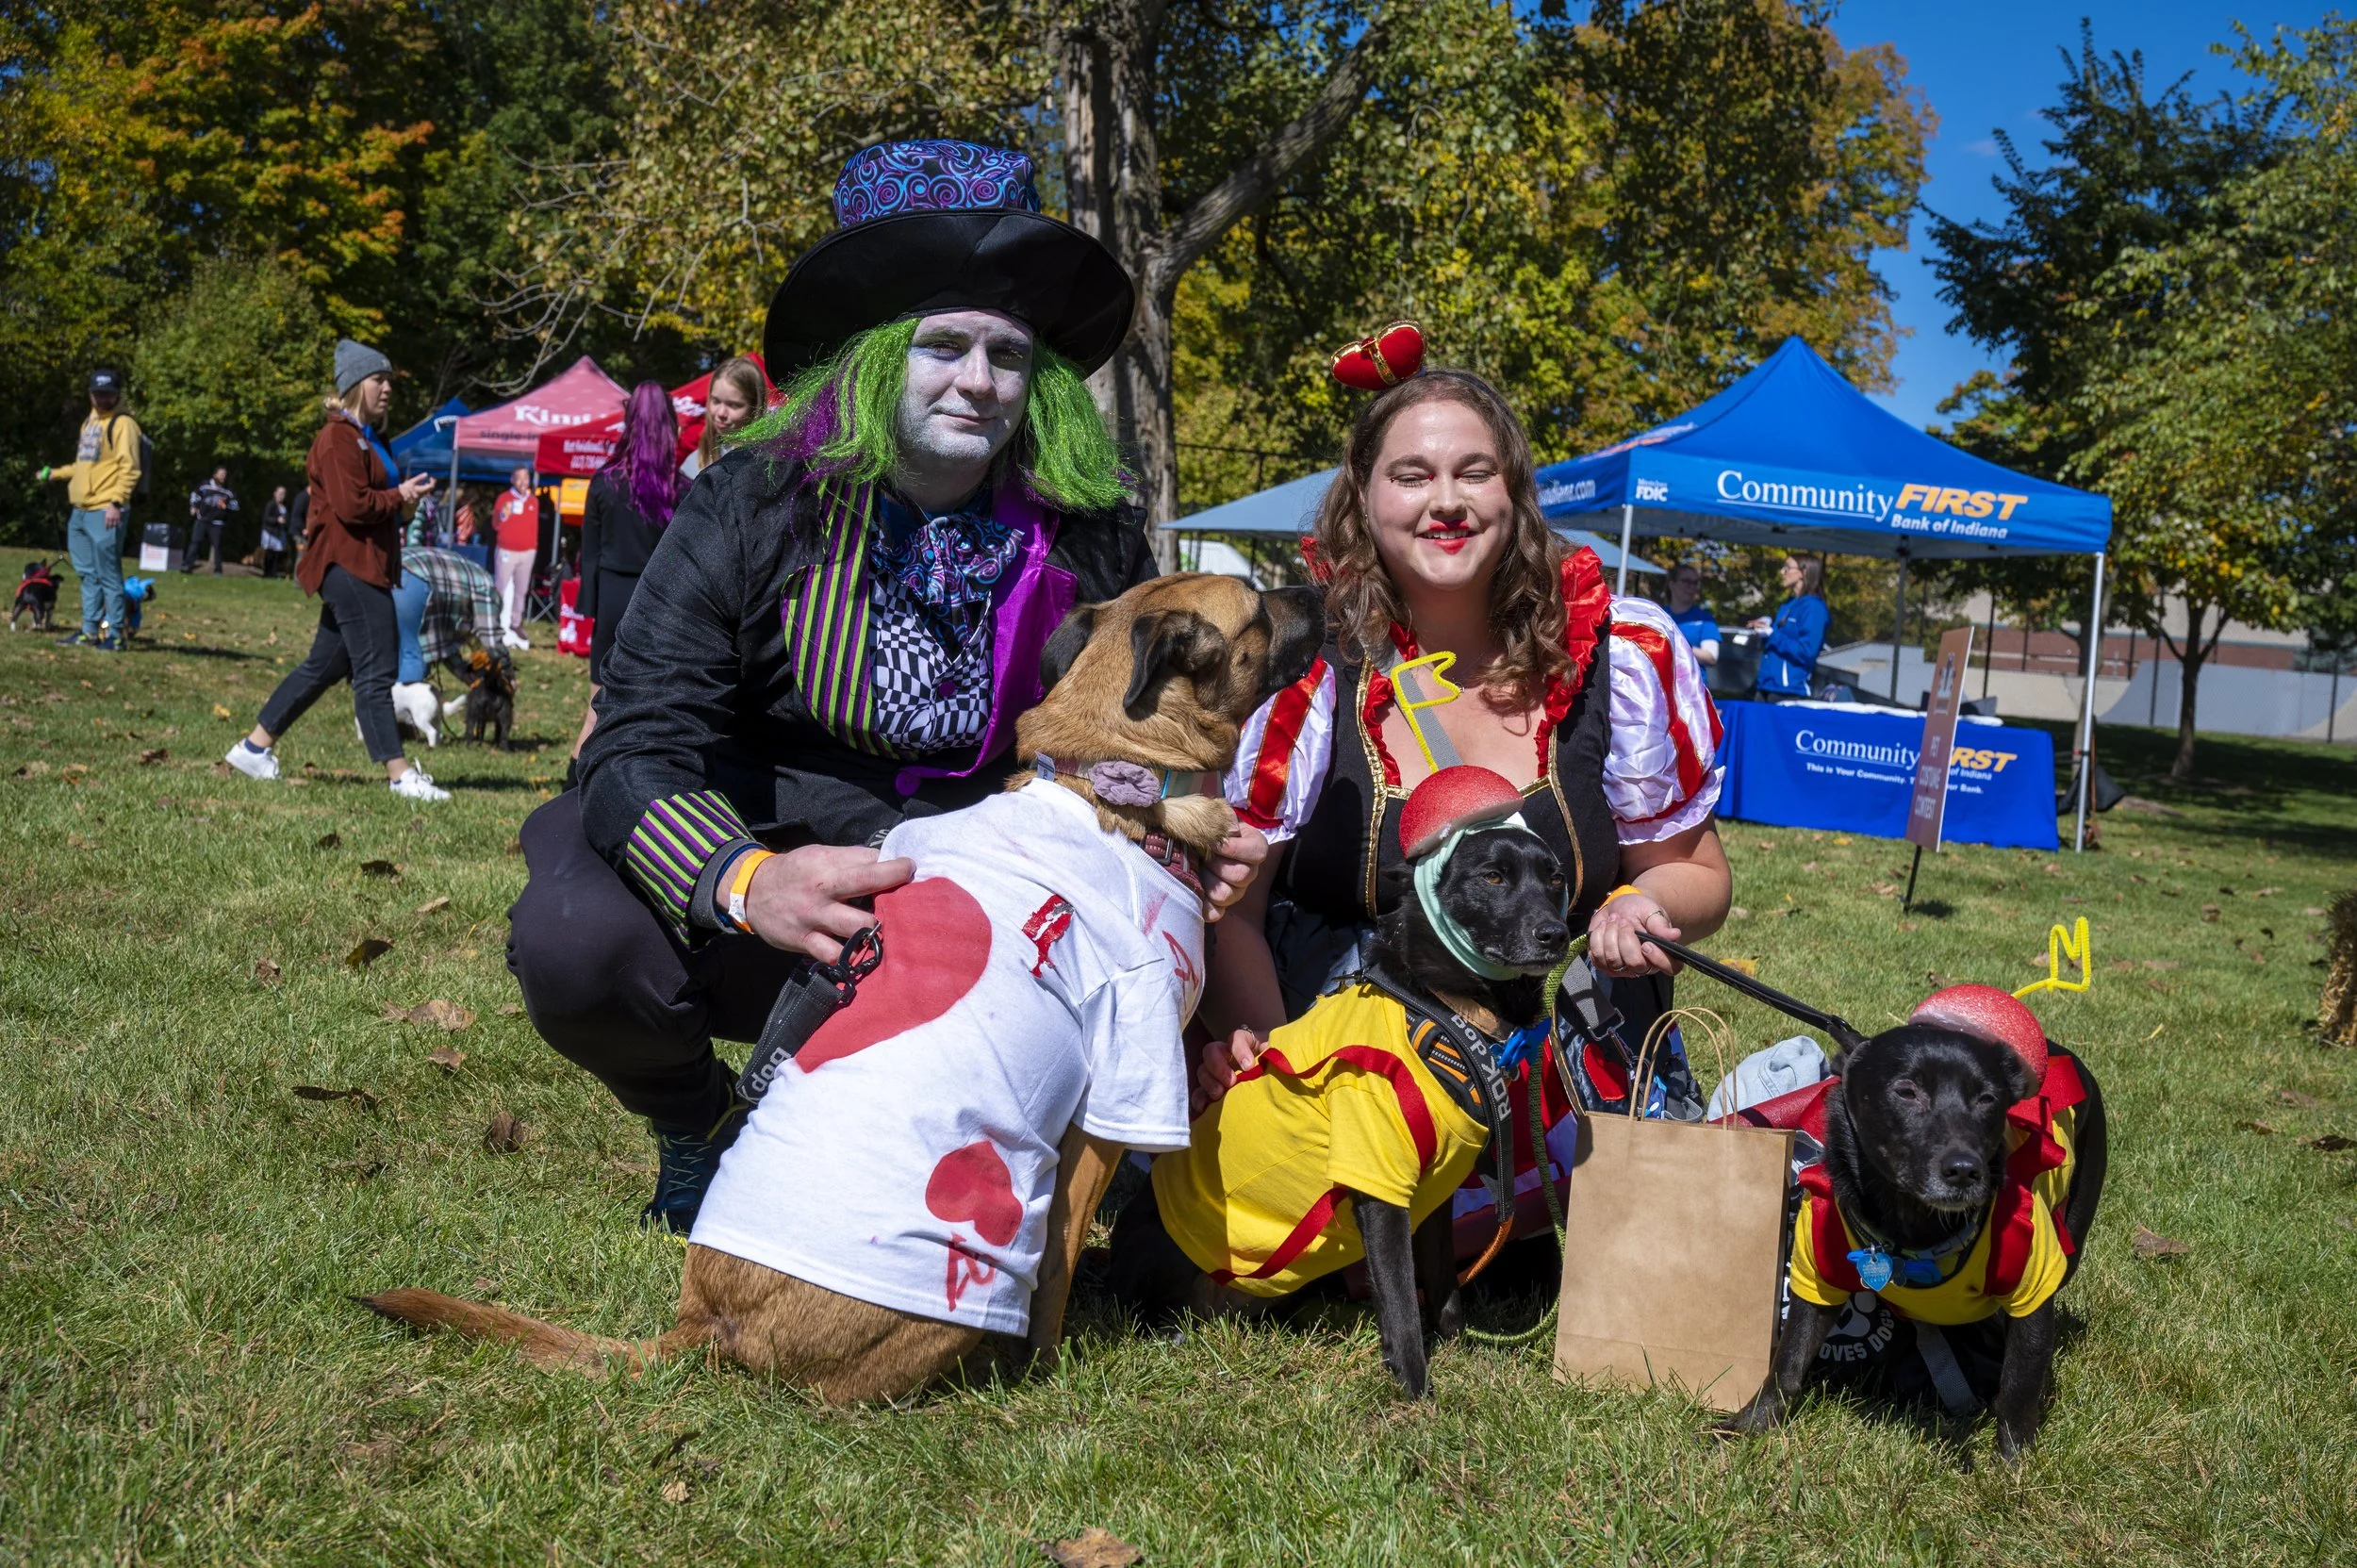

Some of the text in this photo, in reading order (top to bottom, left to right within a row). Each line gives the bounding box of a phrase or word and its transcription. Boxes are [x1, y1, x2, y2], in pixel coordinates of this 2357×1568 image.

[1636, 486, 1668, 502] FDIC
[1716, 470, 2028, 522] Community FIRST
[1890, 514, 2008, 539] Bank of Indiana
[1795, 729, 2018, 773] Community RST
[1806, 762, 1824, 773] This
[1836, 767, 1855, 777] Your
[1960, 768, 1992, 781] Indiana
[1819, 1342, 1868, 1362] OVES
